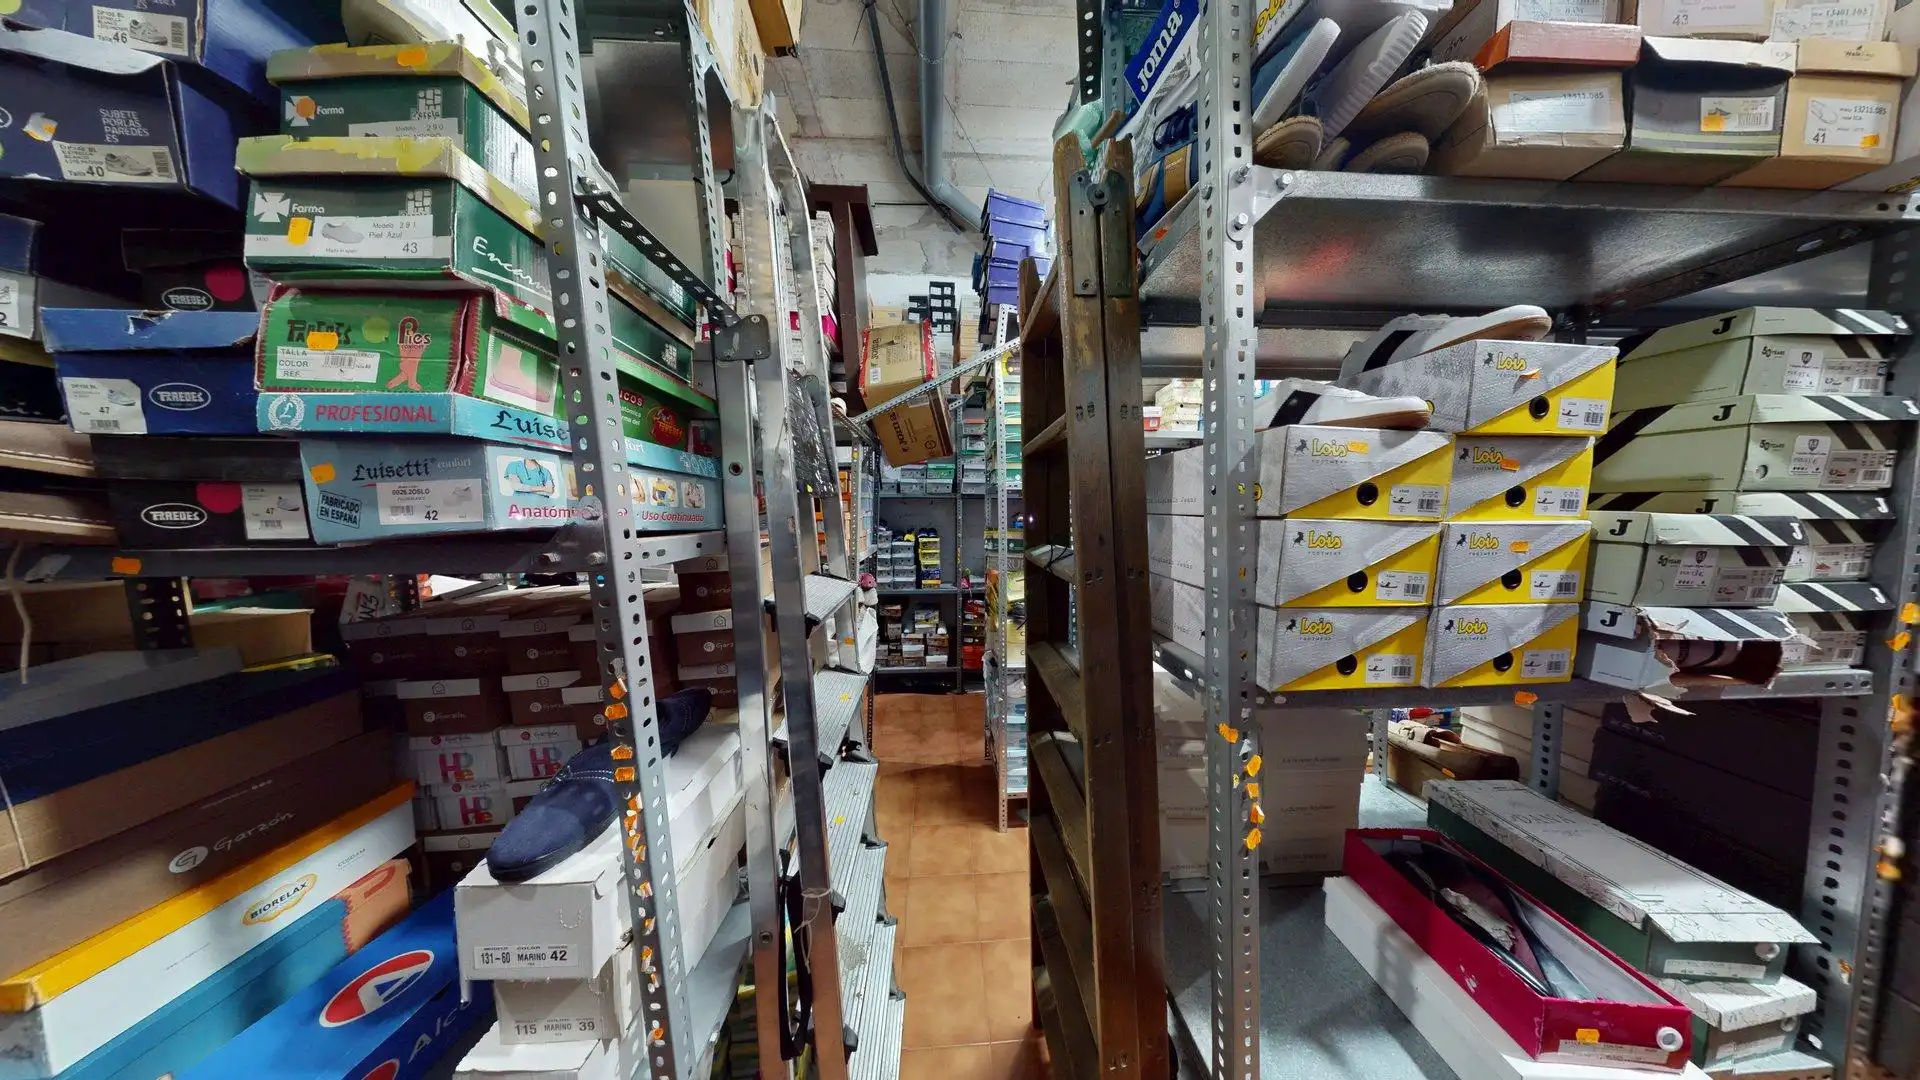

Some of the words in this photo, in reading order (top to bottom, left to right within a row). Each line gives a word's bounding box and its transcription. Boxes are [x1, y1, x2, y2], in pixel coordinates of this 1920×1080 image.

[1672, 14, 1689, 26] 43
[112, 32, 128, 44] 46
[1137, 10, 1184, 93] Joma
[99, 108, 138, 119] SUBETE
[316, 104, 345, 116] Farma
[104, 126, 151, 137] PAREDES
[1812, 131, 1826, 144] 41
[86, 165, 105, 177] 40
[291, 202, 326, 214] Farma
[368, 231, 383, 239] Piel
[386, 231, 403, 239] Azul
[402, 242, 418, 254] 43
[398, 316, 432, 345] Pies
[1712, 315, 1738, 335] J
[278, 360, 309, 368] COLOR
[1495, 351, 1527, 371] Lois
[315, 404, 437, 423] PROFESIONAL
[1711, 404, 1737, 422] J
[490, 409, 571, 441] Luise
[1311, 437, 1348, 457] Lois
[1472, 446, 1504, 464] Lois
[351, 458, 432, 482] Luisetti
[436, 457, 471, 472] confort
[321, 494, 360, 514] FABRICADO
[320, 506, 331, 517] EN
[330, 508, 359, 526] ESPAÑA
[424, 510, 439, 521] 42
[641, 510, 660, 521] Uso
[661, 511, 705, 522] Continuado
[1609, 519, 1633, 537] J
[1308, 529, 1343, 549] Lois
[1469, 531, 1500, 550] Lois
[1300, 617, 1333, 635] Lois
[1456, 617, 1489, 635] Lois
[1600, 610, 1622, 628] J
[212, 810, 297, 851] Garzón
[249, 881, 308, 920] BIORELAX
[480, 951, 511, 965] 131-60
[517, 953, 547, 962] MARINO
[550, 950, 568, 962] 42
[514, 1023, 537, 1035] 115
[544, 1023, 572, 1032] MARINO
[578, 1021, 596, 1032] 39
